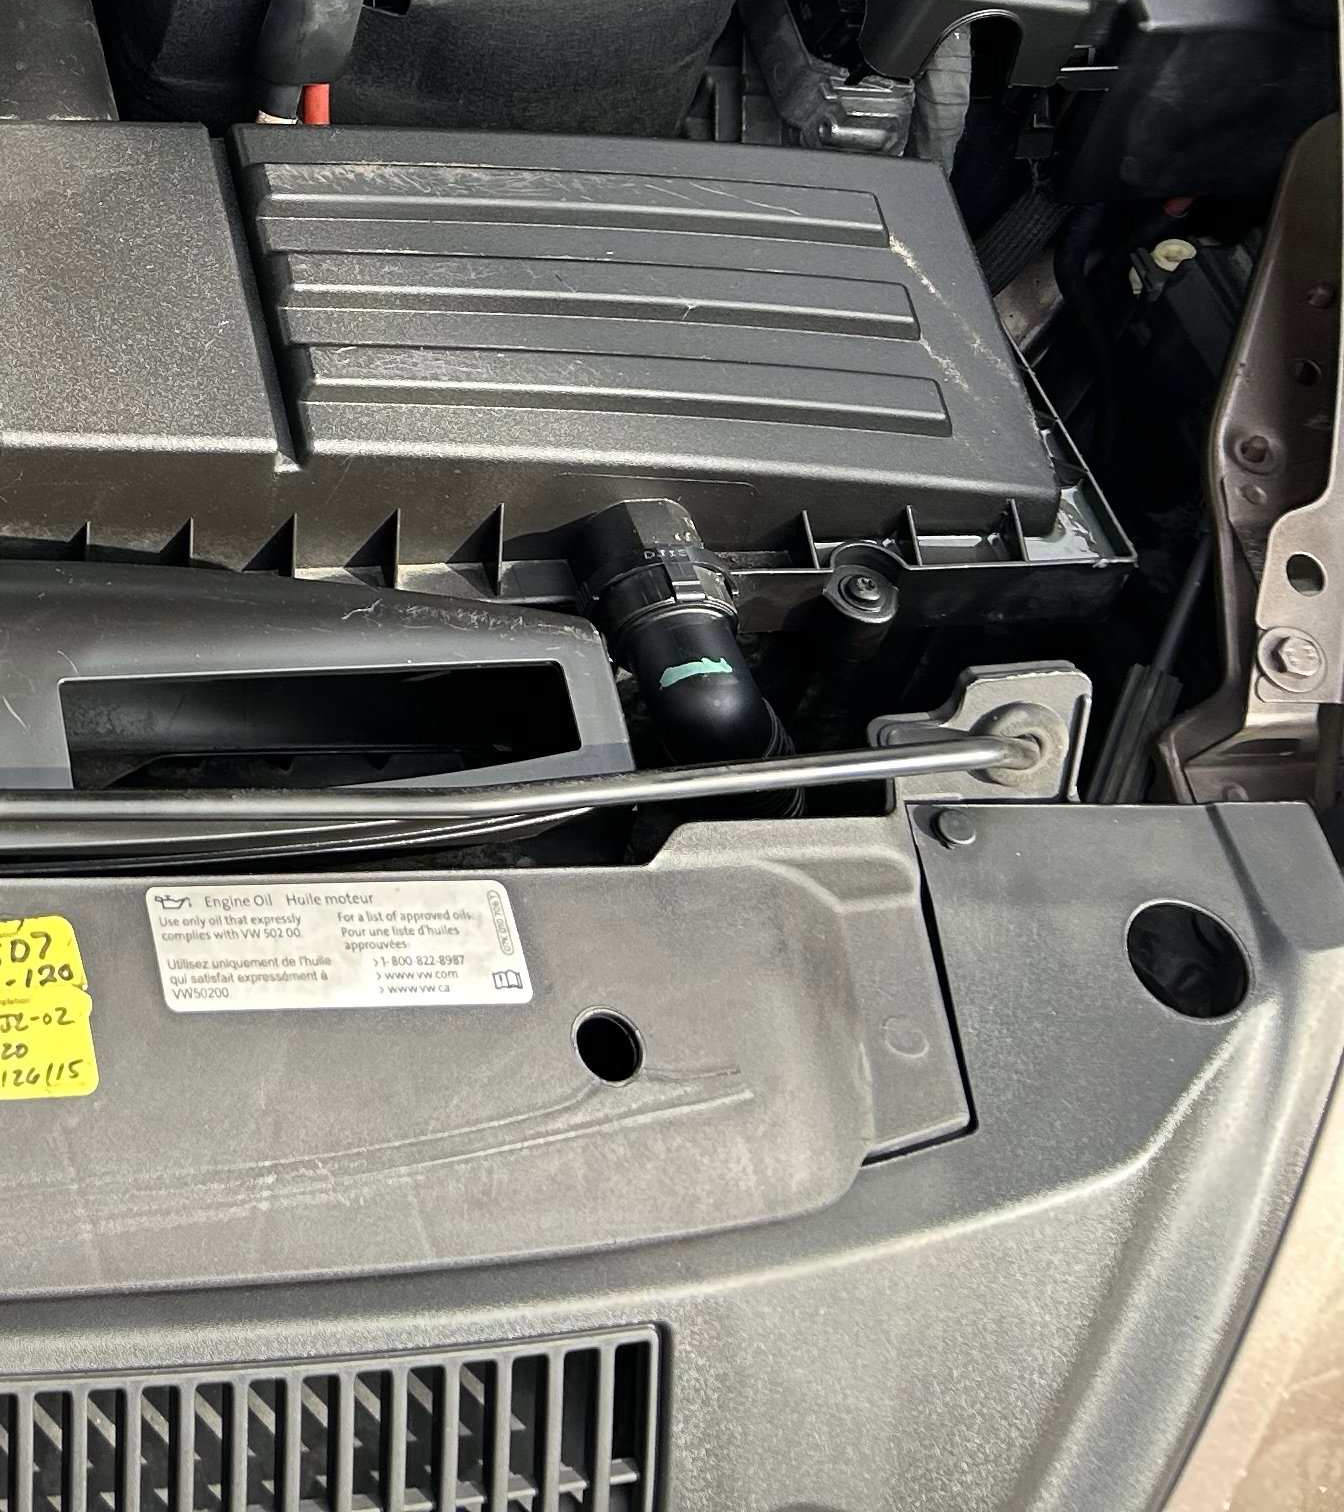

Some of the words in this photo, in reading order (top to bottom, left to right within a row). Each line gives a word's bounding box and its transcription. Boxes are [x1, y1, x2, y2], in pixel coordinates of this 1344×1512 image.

[204, 895, 251, 911] Engine
[254, 894, 272, 906] Oil
[286, 893, 322, 905] Huile
[325, 893, 374, 905] moteur
[159, 917, 179, 927] Use
[183, 916, 206, 929] only
[209, 916, 222, 926] oil
[225, 915, 248, 925] that
[251, 913, 301, 927] expressly
[338, 912, 355, 922] For
[366, 911, 384, 921] list
[386, 911, 398, 921] of
[400, 910, 450, 924] approved
[162, 930, 211, 942] complies
[214, 930, 239, 940] with
[242, 930, 261, 939] VW
[264, 928, 285, 938] 502
[341, 927, 365, 937] Pour
[369, 927, 390, 936] une
[392, 925, 415, 936] liste
[167, 958, 208, 970] Utilisez
[212, 957, 279, 970] uniquement
[282, 956, 295, 966] de
[170, 974, 187, 986] qui
[191, 973, 234, 984] satisfait
[321, 969, 328, 980] à
